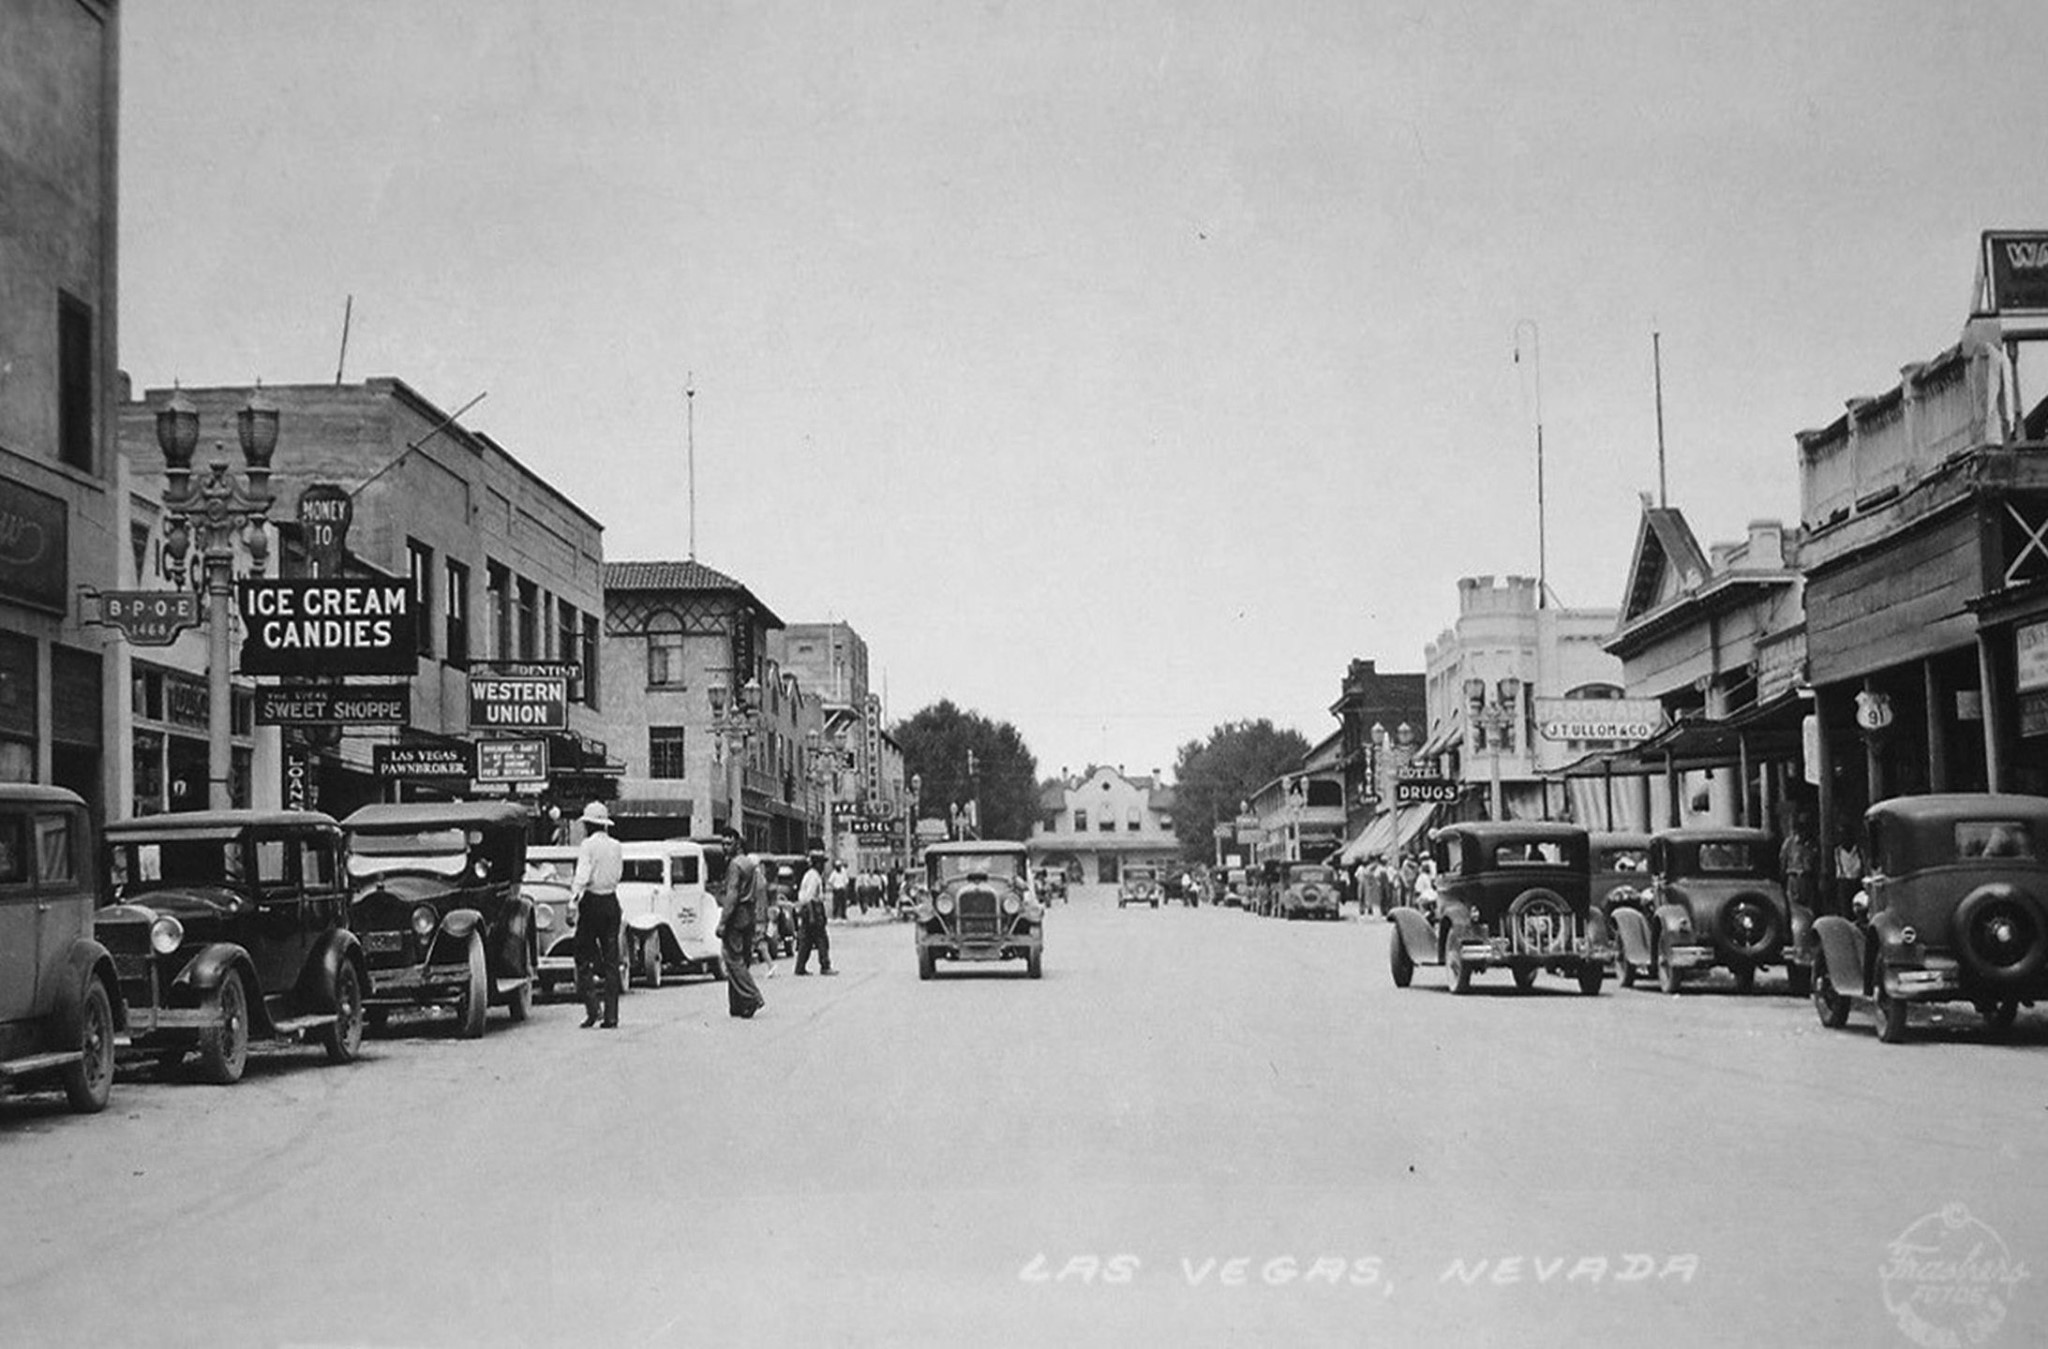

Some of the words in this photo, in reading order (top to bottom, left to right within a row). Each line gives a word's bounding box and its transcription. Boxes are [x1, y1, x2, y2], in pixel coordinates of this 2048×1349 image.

[303, 499, 347, 521] MONEY
[314, 525, 333, 545] TO
[248, 588, 294, 616] ICE
[303, 588, 406, 616] CREAM
[263, 620, 392, 648] CANDIES
[519, 665, 579, 678] DENTIST
[471, 682, 562, 702] WESTERN
[264, 701, 327, 719] SWEET
[333, 701, 402, 719] SHOPPE
[486, 704, 548, 724] UNION
[1868, 710, 1884, 725] 91
[391, 751, 415, 762] LAS
[419, 751, 457, 762] VEGAS
[381, 762, 467, 775] PAWNBROKER
[1399, 785, 1456, 800] DRUGS
